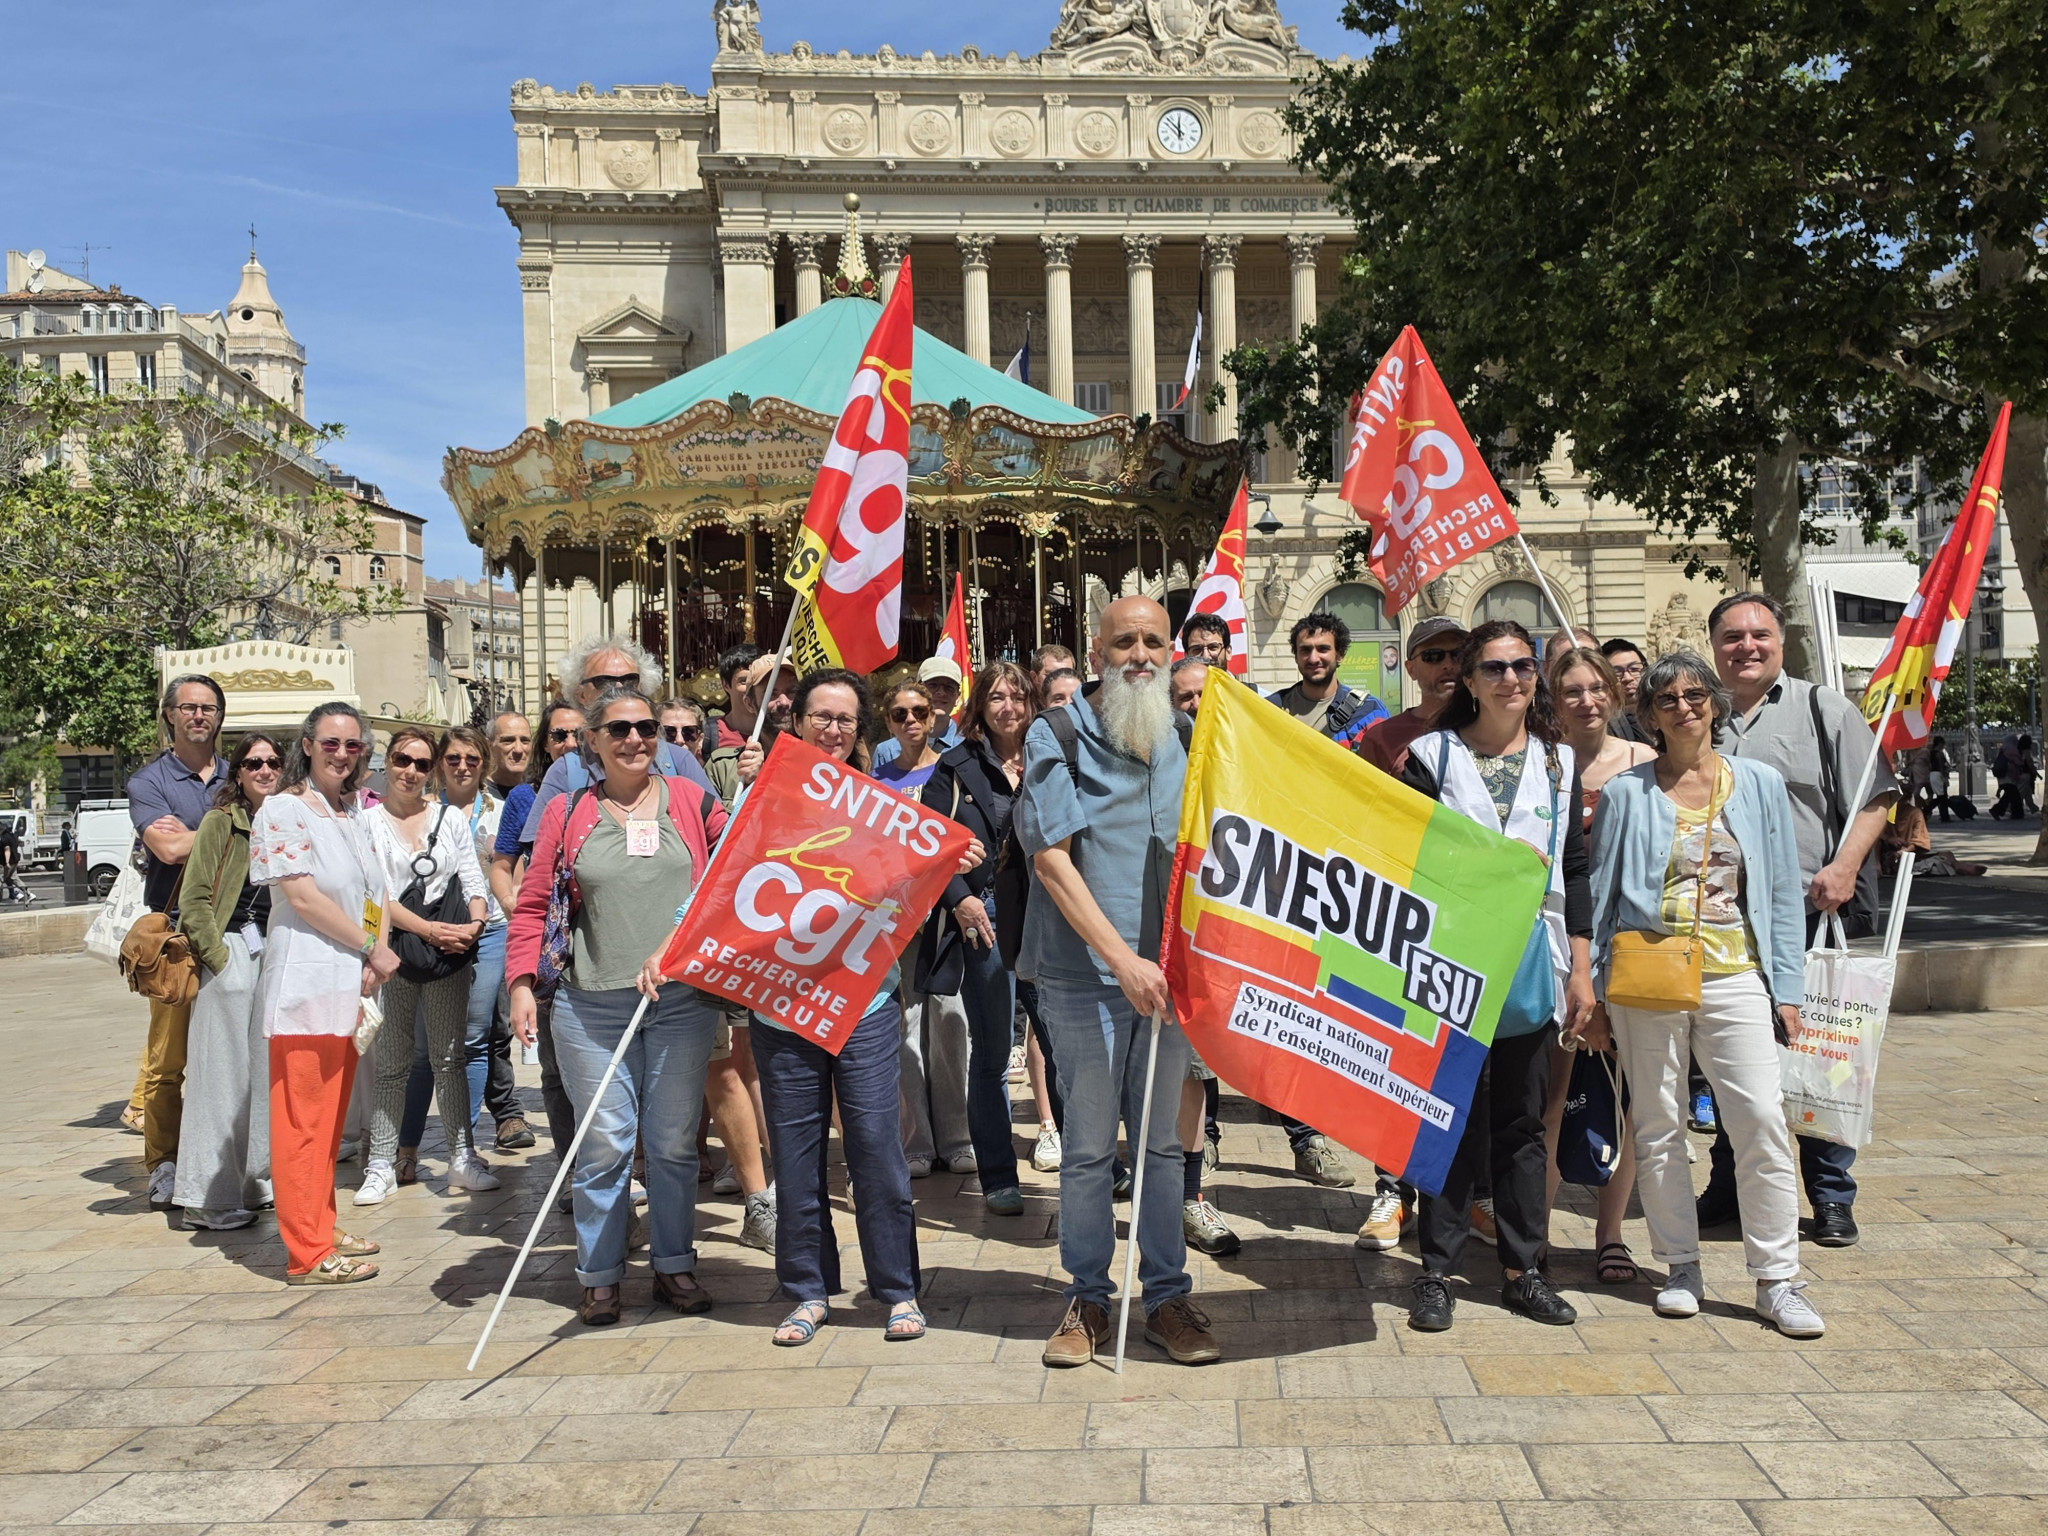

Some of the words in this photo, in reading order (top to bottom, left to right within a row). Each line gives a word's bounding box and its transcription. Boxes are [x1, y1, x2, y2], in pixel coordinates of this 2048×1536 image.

[1045, 198, 1098, 213] BOURSE
[1108, 198, 1127, 213] ET
[1134, 198, 1203, 213] CHAMBRE
[1213, 198, 1231, 213] DE
[1240, 198, 1318, 213] COMMERCE
[801, 762, 946, 857] SNTRS
[765, 826, 902, 914] la
[1200, 814, 1431, 967] SNESUP
[683, 960, 835, 1039] PUBLIQUE
[697, 936, 848, 1016] RECHERCHE
[1406, 951, 1478, 1025] FSU
[1844, 1001, 1878, 1016] porter
[1242, 986, 1323, 1034] Syndicat
[1326, 1023, 1390, 1066] national
[1820, 1047, 1848, 1061] vous
[1234, 1012, 1257, 1031] de
[1387, 1076, 1450, 1124] supérieur
